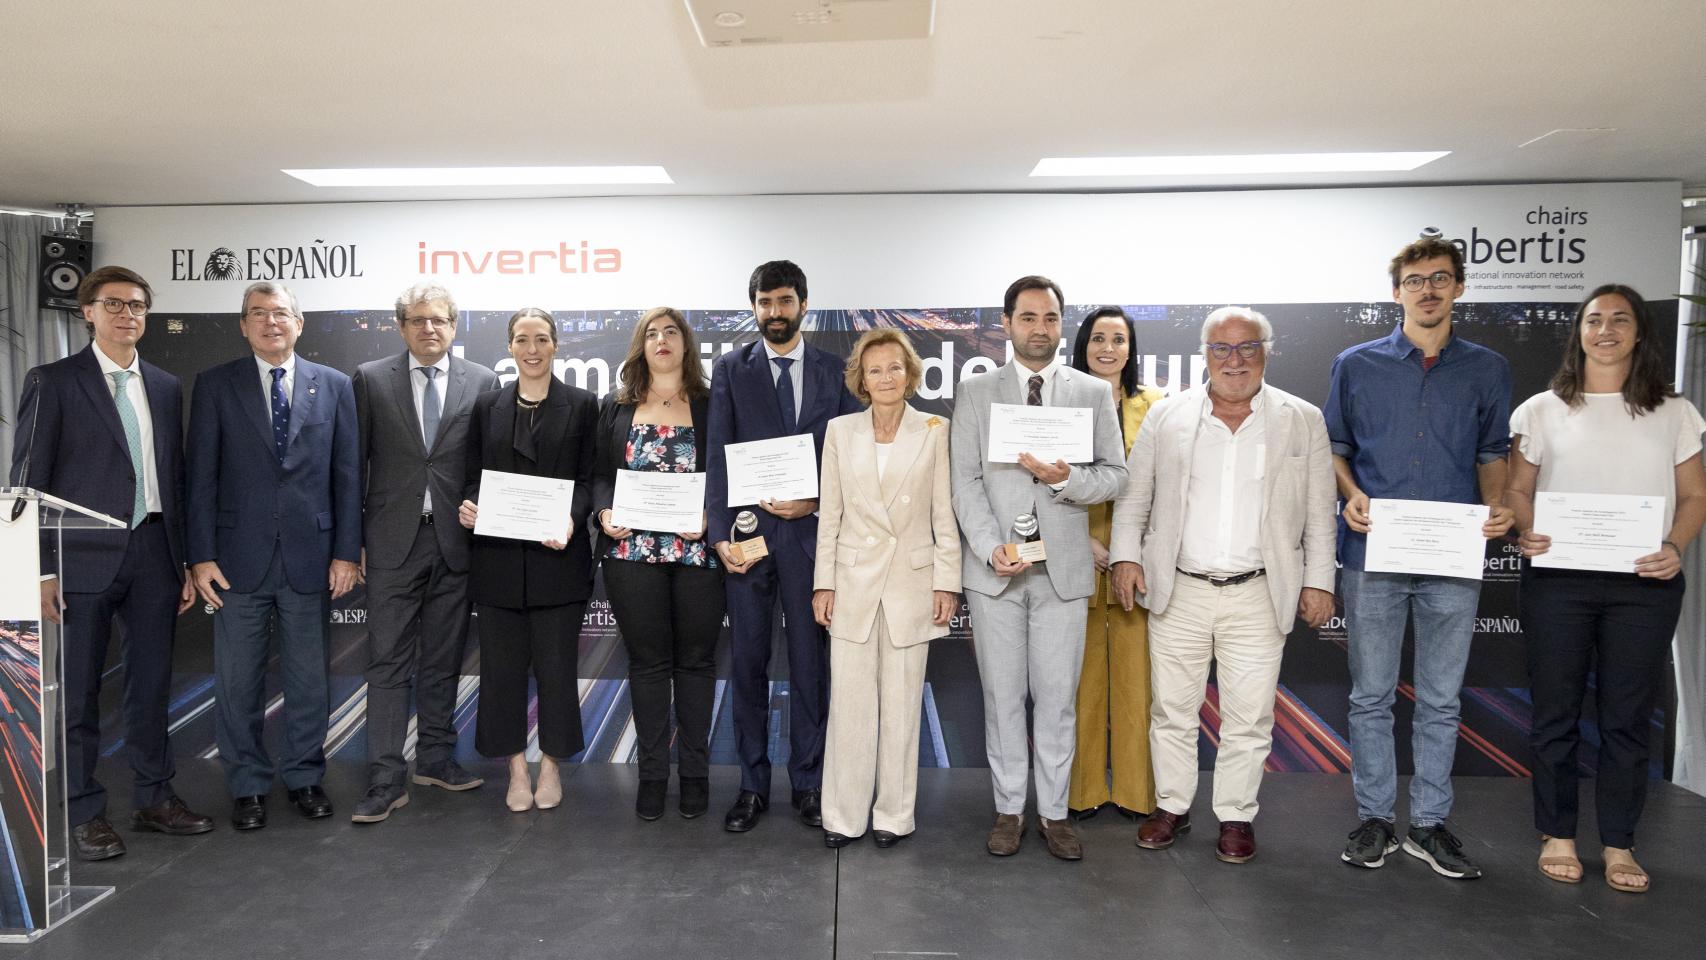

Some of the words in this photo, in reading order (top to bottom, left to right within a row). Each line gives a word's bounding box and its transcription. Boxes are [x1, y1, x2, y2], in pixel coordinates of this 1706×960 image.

[1526, 205, 1589, 225] chairs
[171, 249, 200, 281] EL
[246, 238, 364, 280] ESPAÑOL
[418, 240, 622, 274] invertia
[1502, 270, 1547, 280] innovation
[1549, 270, 1585, 279] network
[582, 609, 617, 626] ertis
[1472, 615, 1524, 633] ESPAÑO
